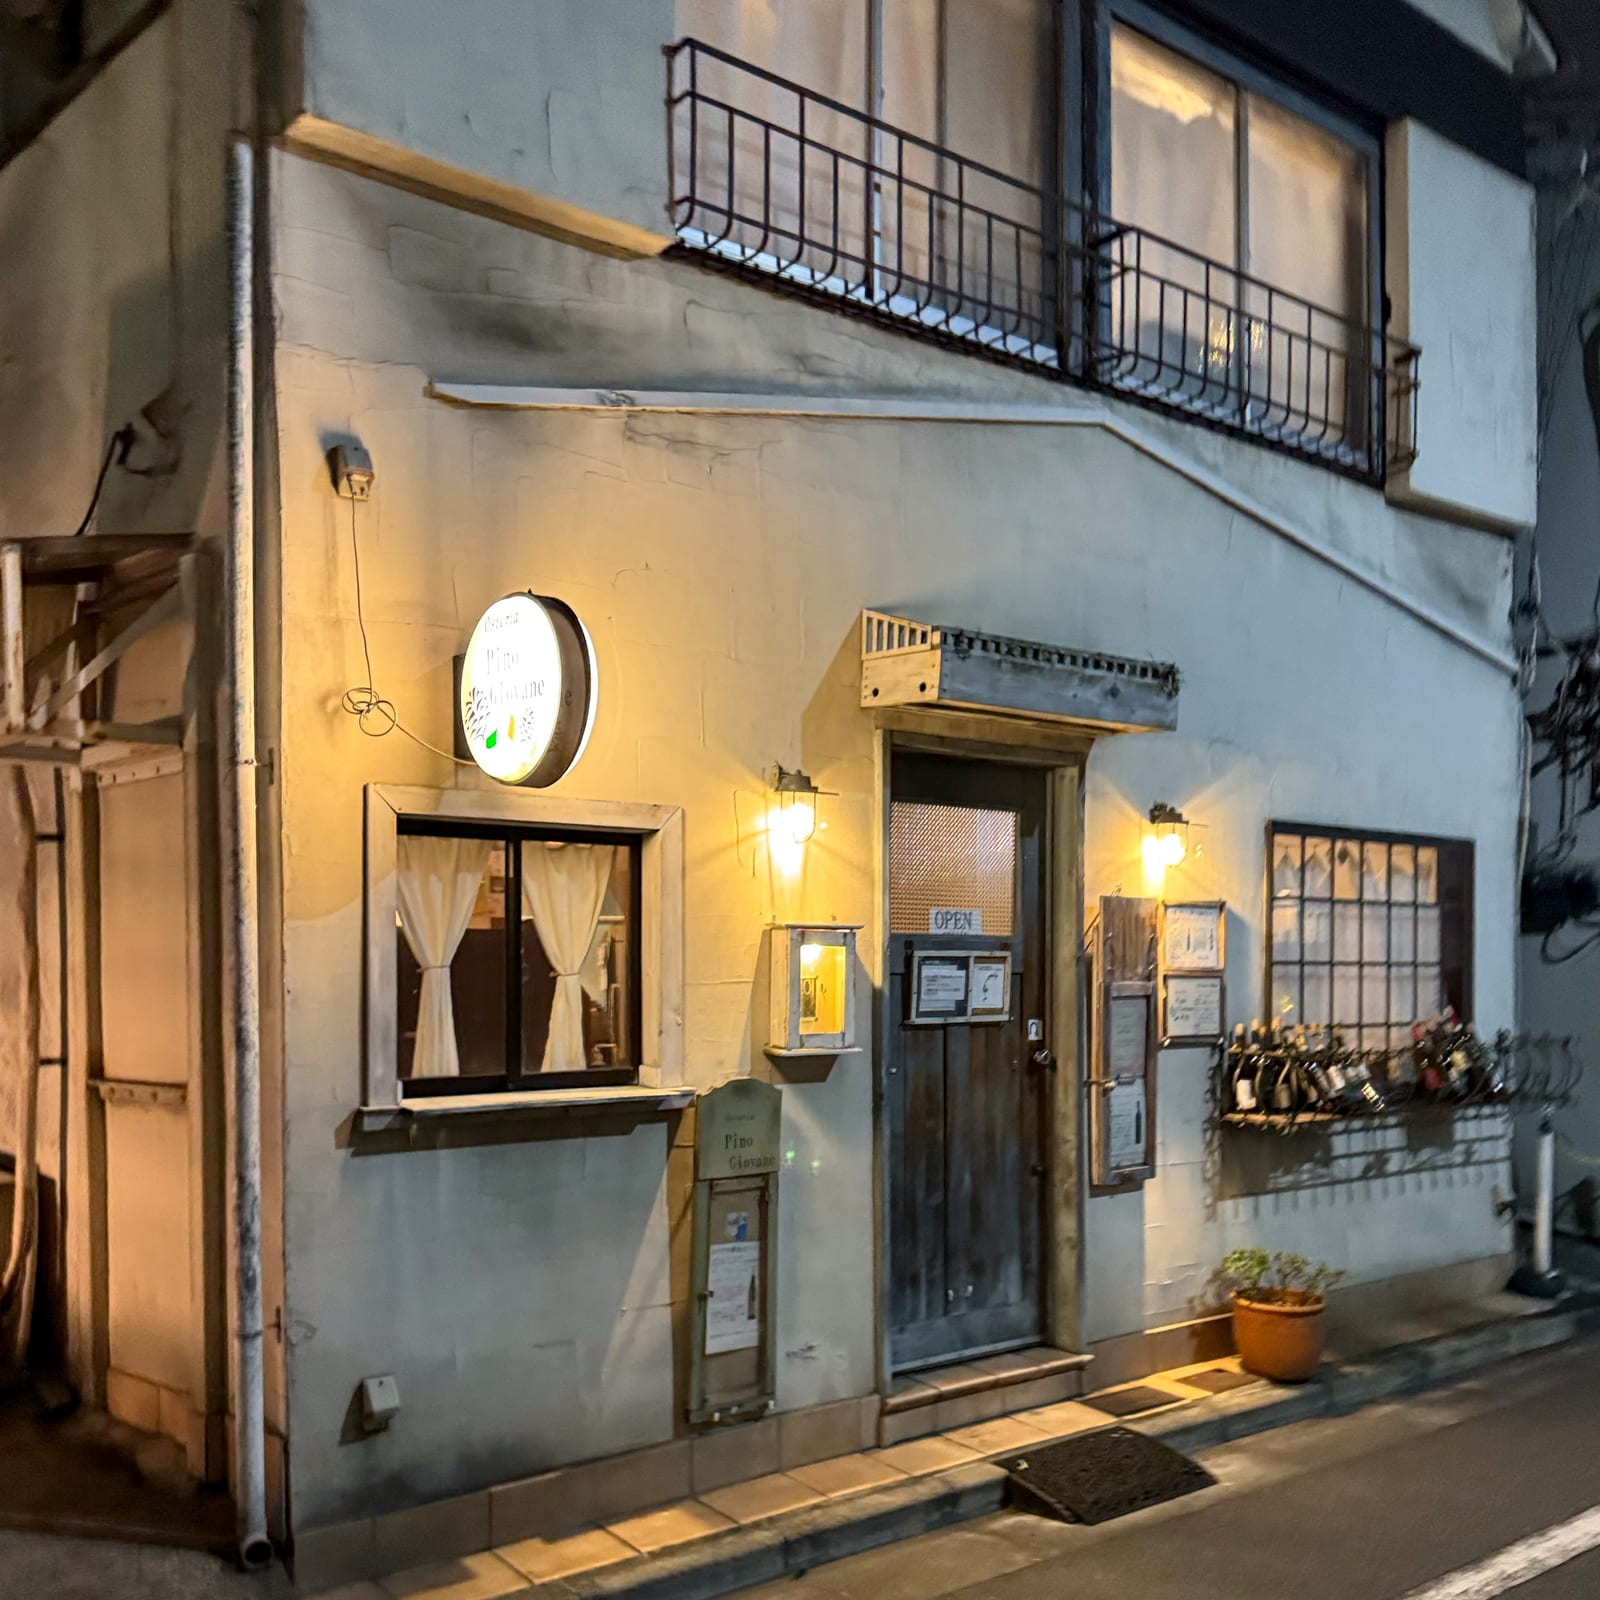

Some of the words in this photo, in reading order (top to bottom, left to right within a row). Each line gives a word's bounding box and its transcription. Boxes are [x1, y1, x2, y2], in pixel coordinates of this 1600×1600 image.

[487, 648, 519, 675] Pino
[935, 911, 972, 930] OPEN
[725, 1133, 753, 1150] Pino
[729, 1155, 776, 1170] Giovane
